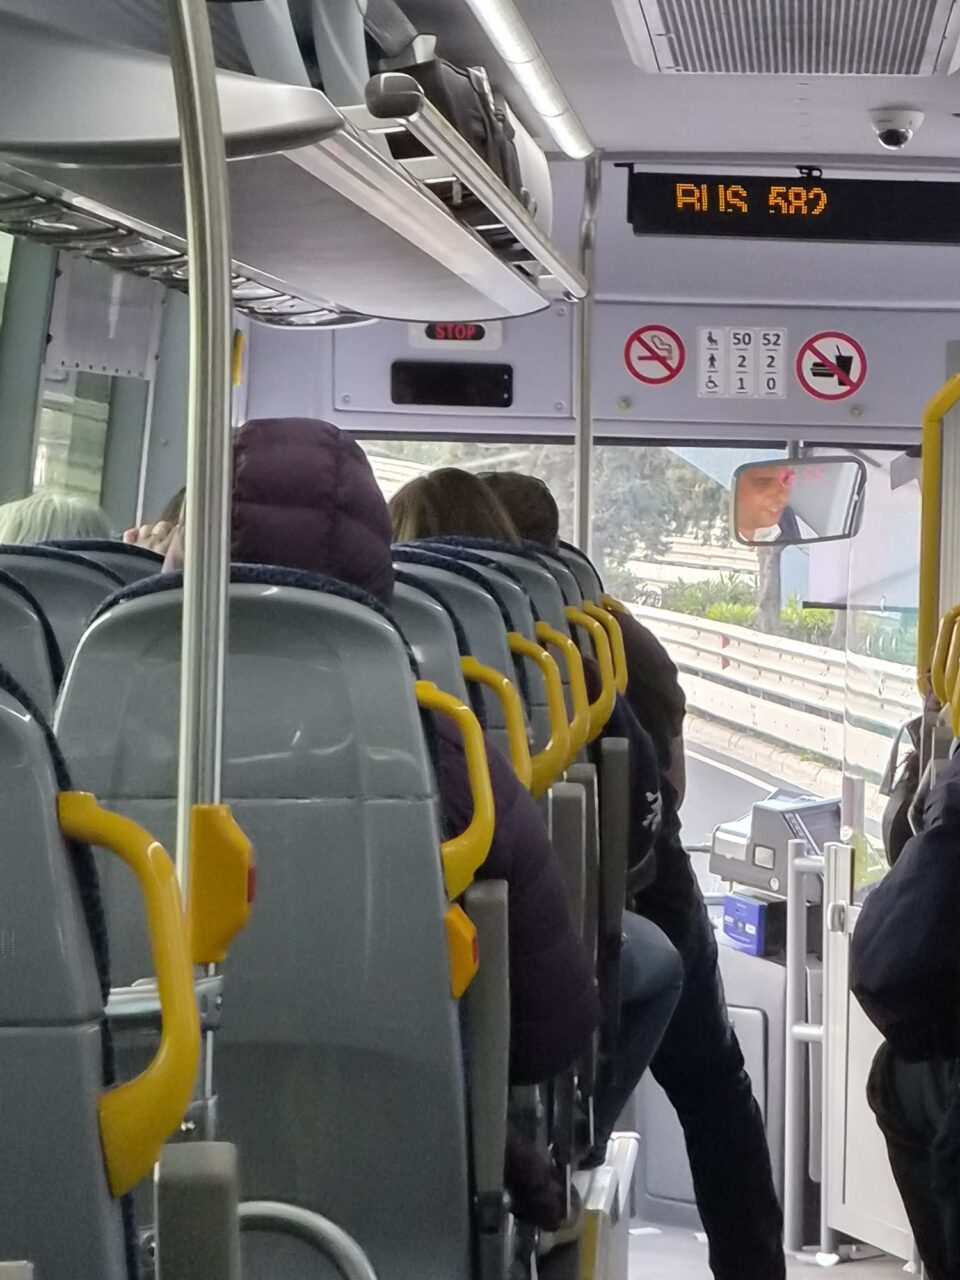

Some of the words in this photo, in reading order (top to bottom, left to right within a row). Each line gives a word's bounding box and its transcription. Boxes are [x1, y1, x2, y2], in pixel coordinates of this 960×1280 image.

[435, 322, 476, 340] STOP
[732, 332, 752, 346] 50
[762, 333, 781, 347] 52
[737, 355, 747, 368] 2
[766, 355, 776, 368] 2
[737, 377, 746, 390] 1
[766, 377, 776, 390] 0
